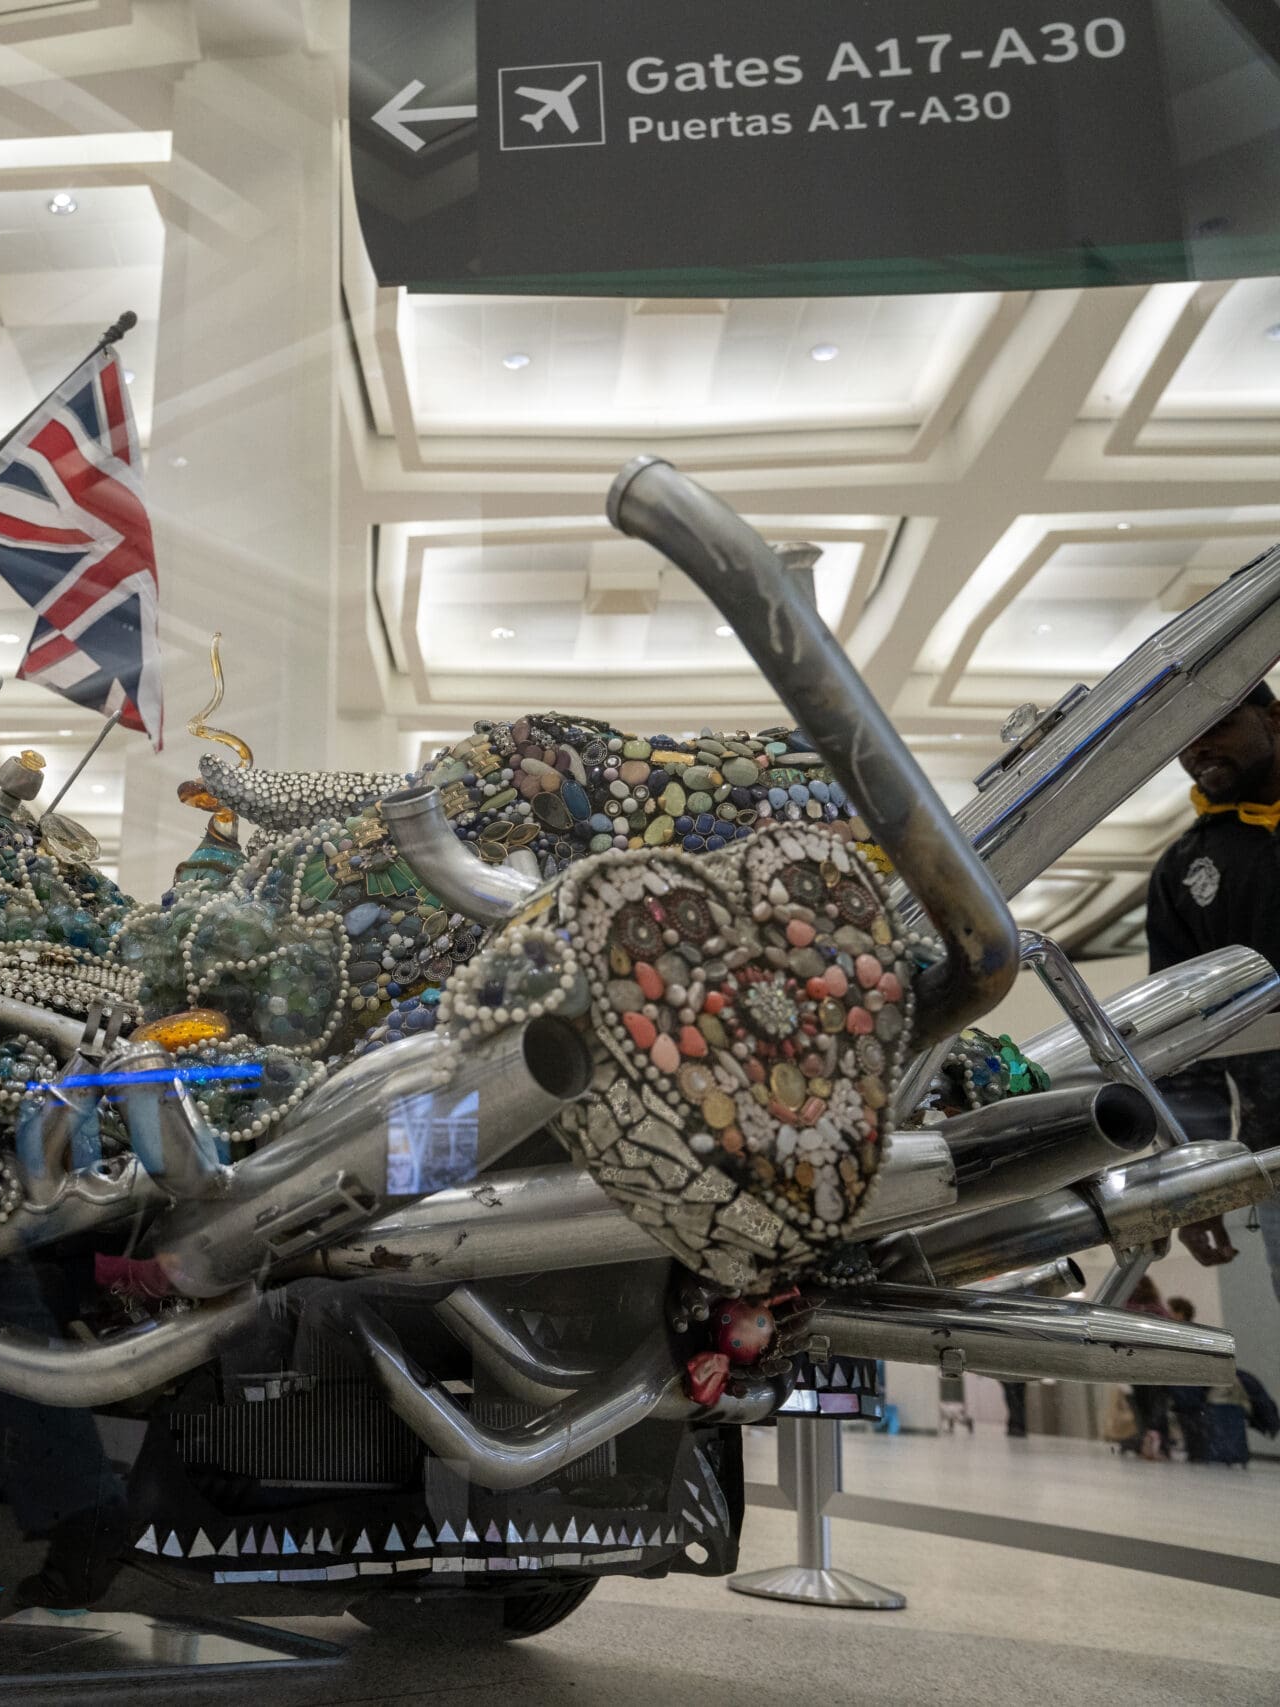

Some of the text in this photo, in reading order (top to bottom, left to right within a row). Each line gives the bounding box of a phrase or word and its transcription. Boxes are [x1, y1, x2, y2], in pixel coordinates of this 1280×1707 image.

[626, 17, 1127, 95] Gates A17-A30
[628, 91, 1012, 144] Puertas A17-A30
